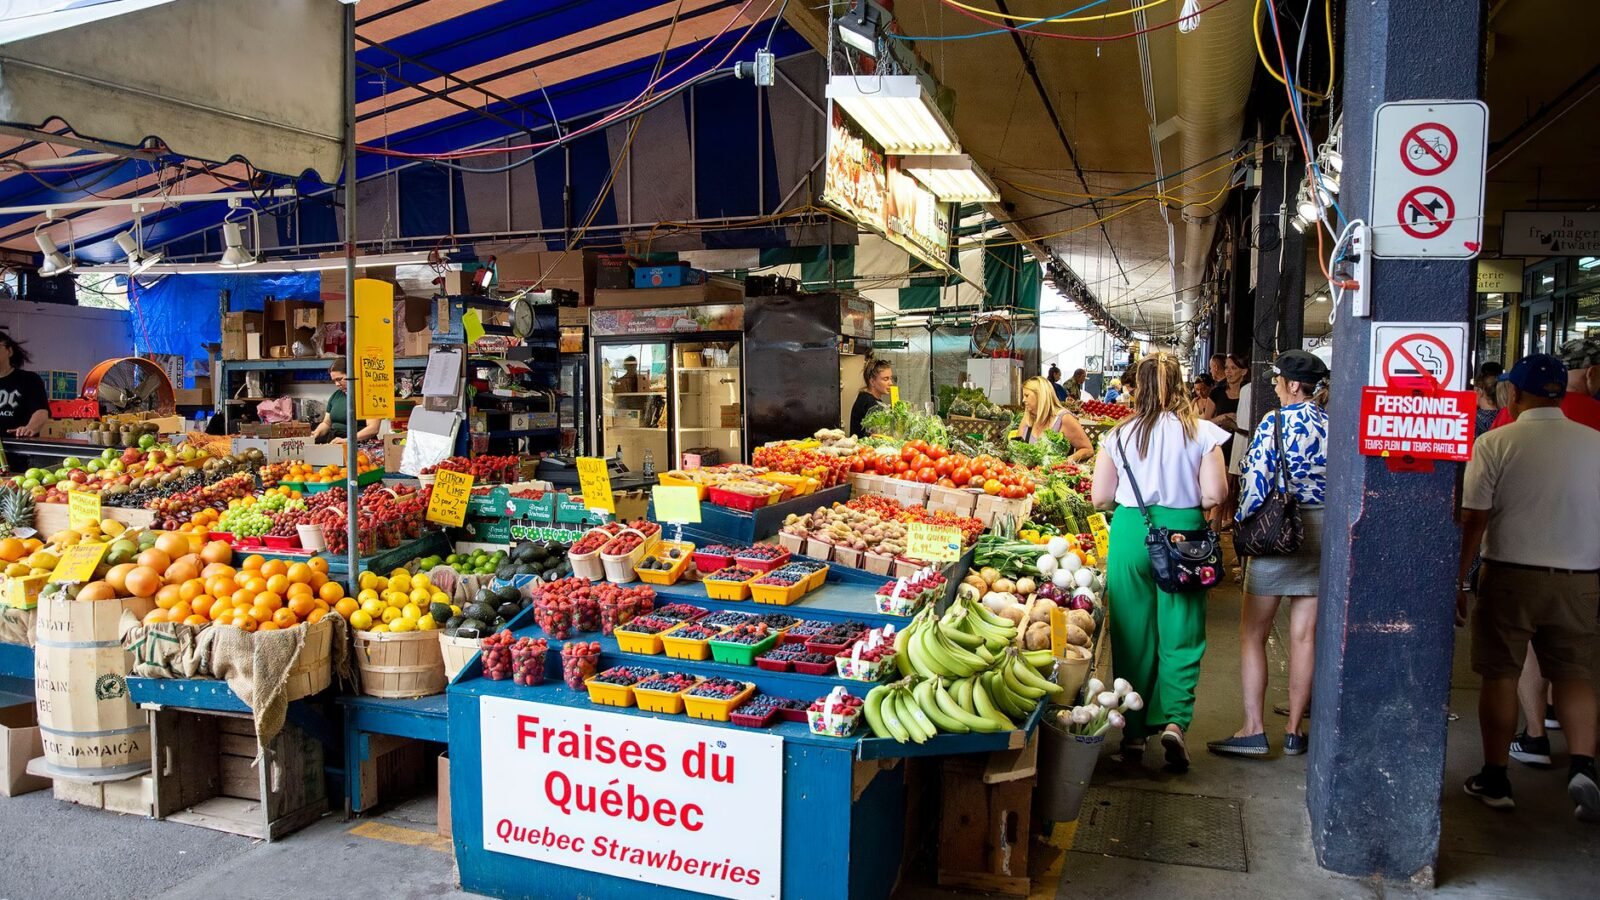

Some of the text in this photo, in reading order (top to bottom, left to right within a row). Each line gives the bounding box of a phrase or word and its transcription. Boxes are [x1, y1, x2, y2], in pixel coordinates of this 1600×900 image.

[1562, 215, 1574, 228] la
[1374, 394, 1461, 416] PERSONNEL
[1366, 413, 1469, 442] DEMANDÉ
[1364, 439, 1457, 454] TEMPS PLEIN TEMPS PARTIEL
[439, 471, 466, 485] CITRON
[432, 493, 440, 504] 3
[446, 485, 466, 497] LIME
[560, 501, 578, 511] Ferme
[50, 743, 63, 754] OF
[68, 740, 140, 757] JAMAICA
[516, 713, 736, 785] Fraises du
[543, 770, 705, 832] Québec
[495, 818, 761, 887] Quebec Strawberries
